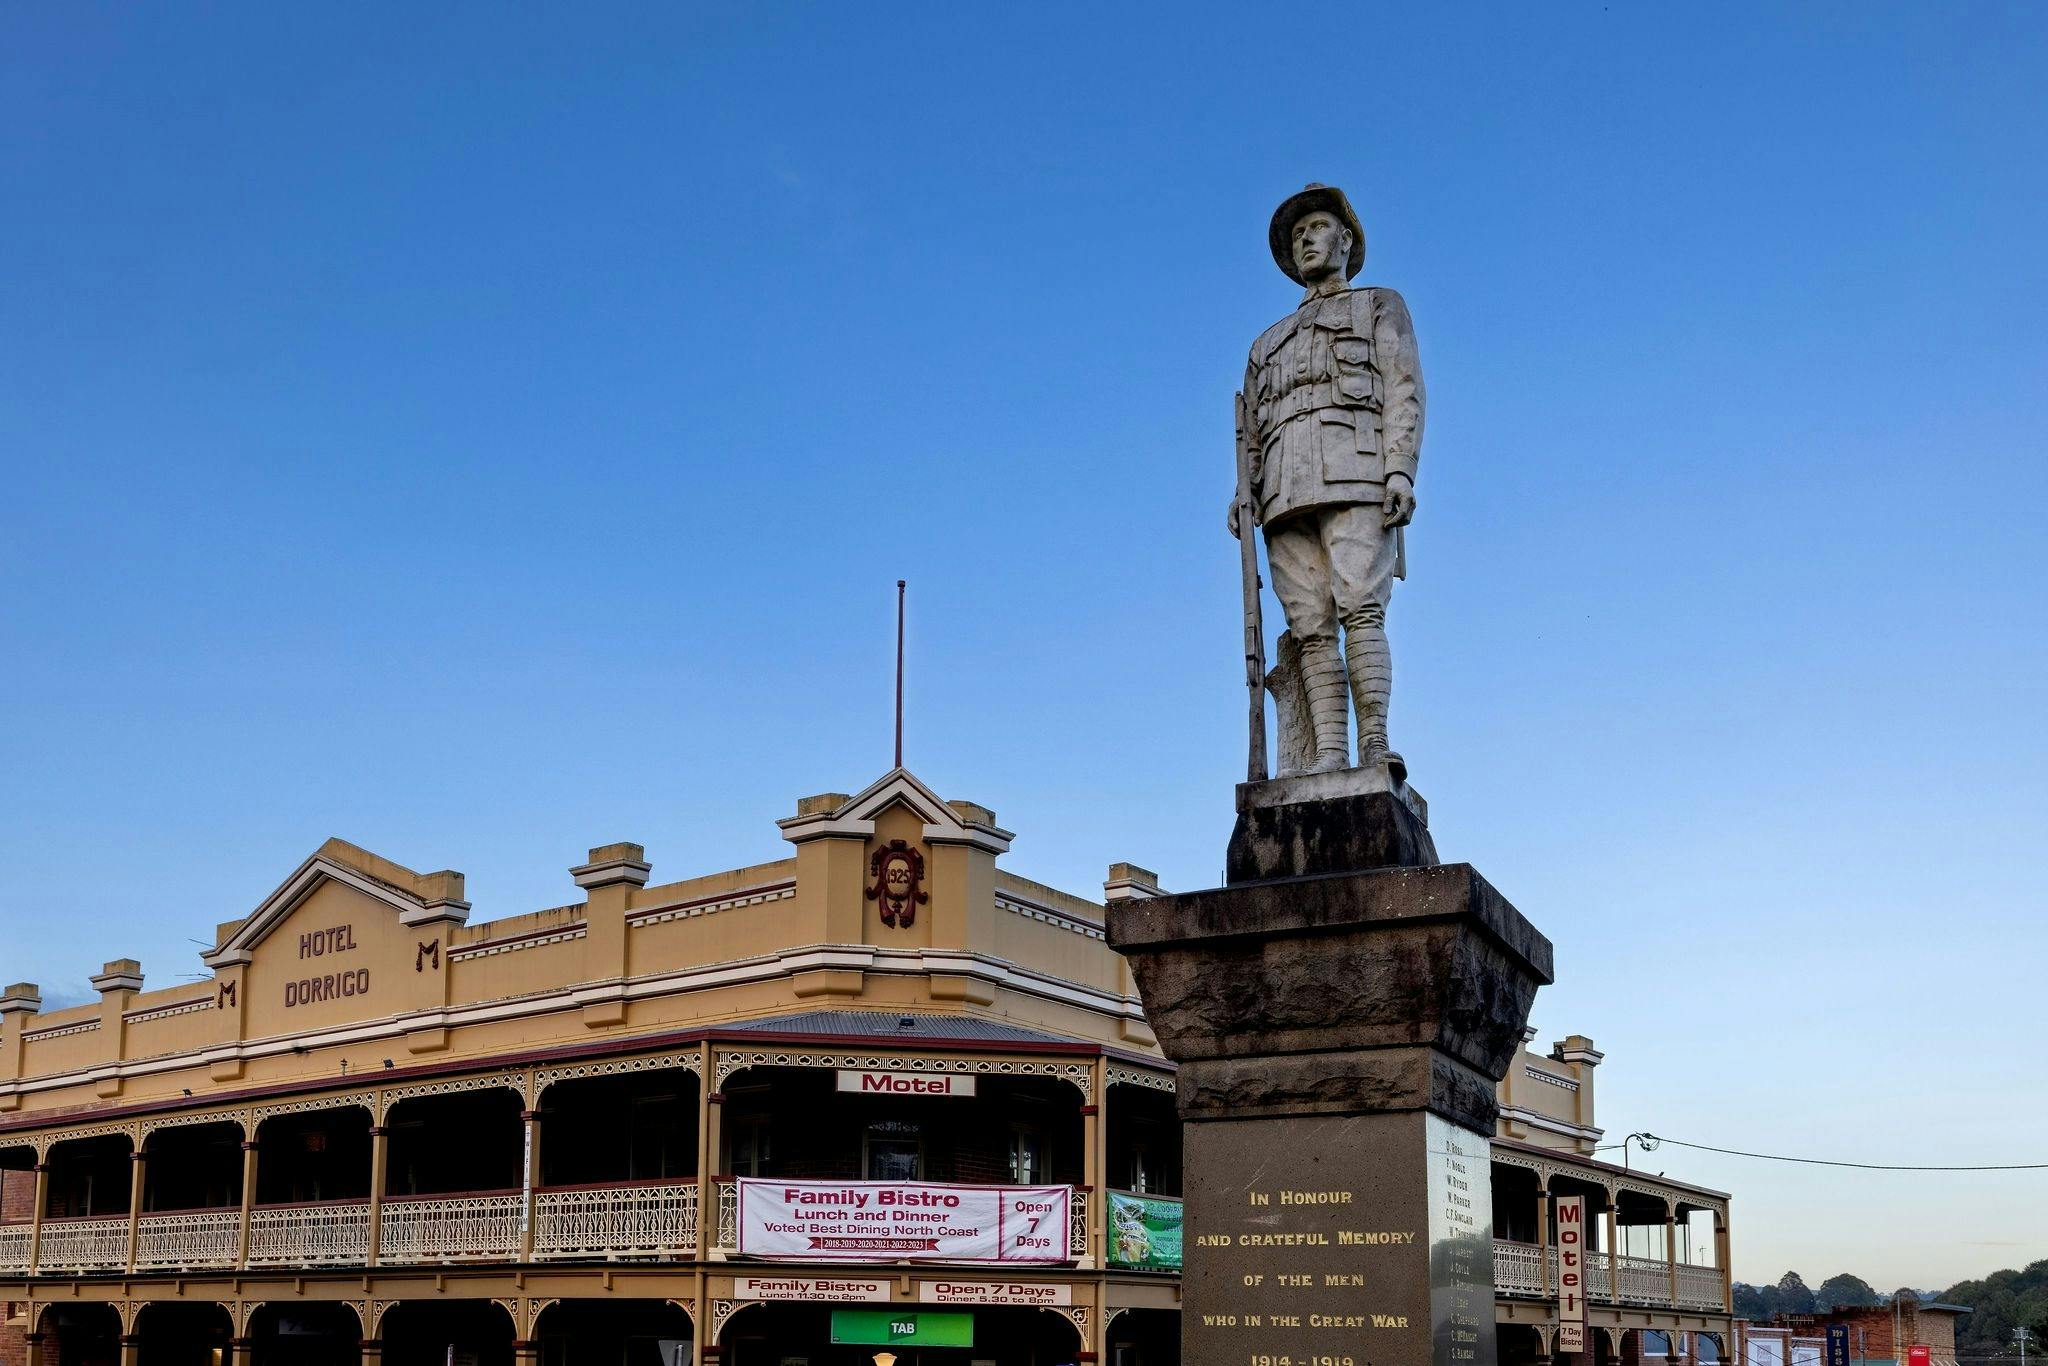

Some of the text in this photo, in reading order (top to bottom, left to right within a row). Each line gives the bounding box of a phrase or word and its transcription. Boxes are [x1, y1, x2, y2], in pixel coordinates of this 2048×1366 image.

[887, 869, 910, 884] 1925
[300, 924, 356, 959] HOTEL
[284, 968, 369, 1007] DORRIGO
[862, 1074, 950, 1094] Motel
[784, 1188, 960, 1208] Family Bistro
[1250, 1190, 1352, 1205] IN HONOUR
[1015, 1200, 1052, 1214] Open
[794, 1209, 950, 1222] Lunch and Dinner
[764, 1222, 979, 1237] Voted Best Dining North Coast
[1028, 1218, 1040, 1234] 7
[1016, 1236, 1050, 1248] Days
[1196, 1234, 1231, 1246] AND
[1239, 1233, 1328, 1246] GRATEFUL
[1338, 1231, 1416, 1244] MEMORY
[1560, 1205, 1580, 1312] Motel
[748, 1280, 878, 1292] Family Bistro
[1244, 1274, 1364, 1286] OF THE MEN
[797, 1292, 825, 1300] 11.30
[936, 1284, 1056, 1298] Open 7 Days
[1012, 1296, 1024, 1304] to
[1028, 1296, 1054, 1304] 8pm
[891, 1322, 914, 1334] TAB
[1203, 1314, 1408, 1328] WHO IN THE GREAT WAR
[1568, 1328, 1582, 1337] Day
[1560, 1338, 1582, 1346] Bistro
[1252, 1356, 1292, 1366] 1914
[1312, 1356, 1354, 1366] 1919
